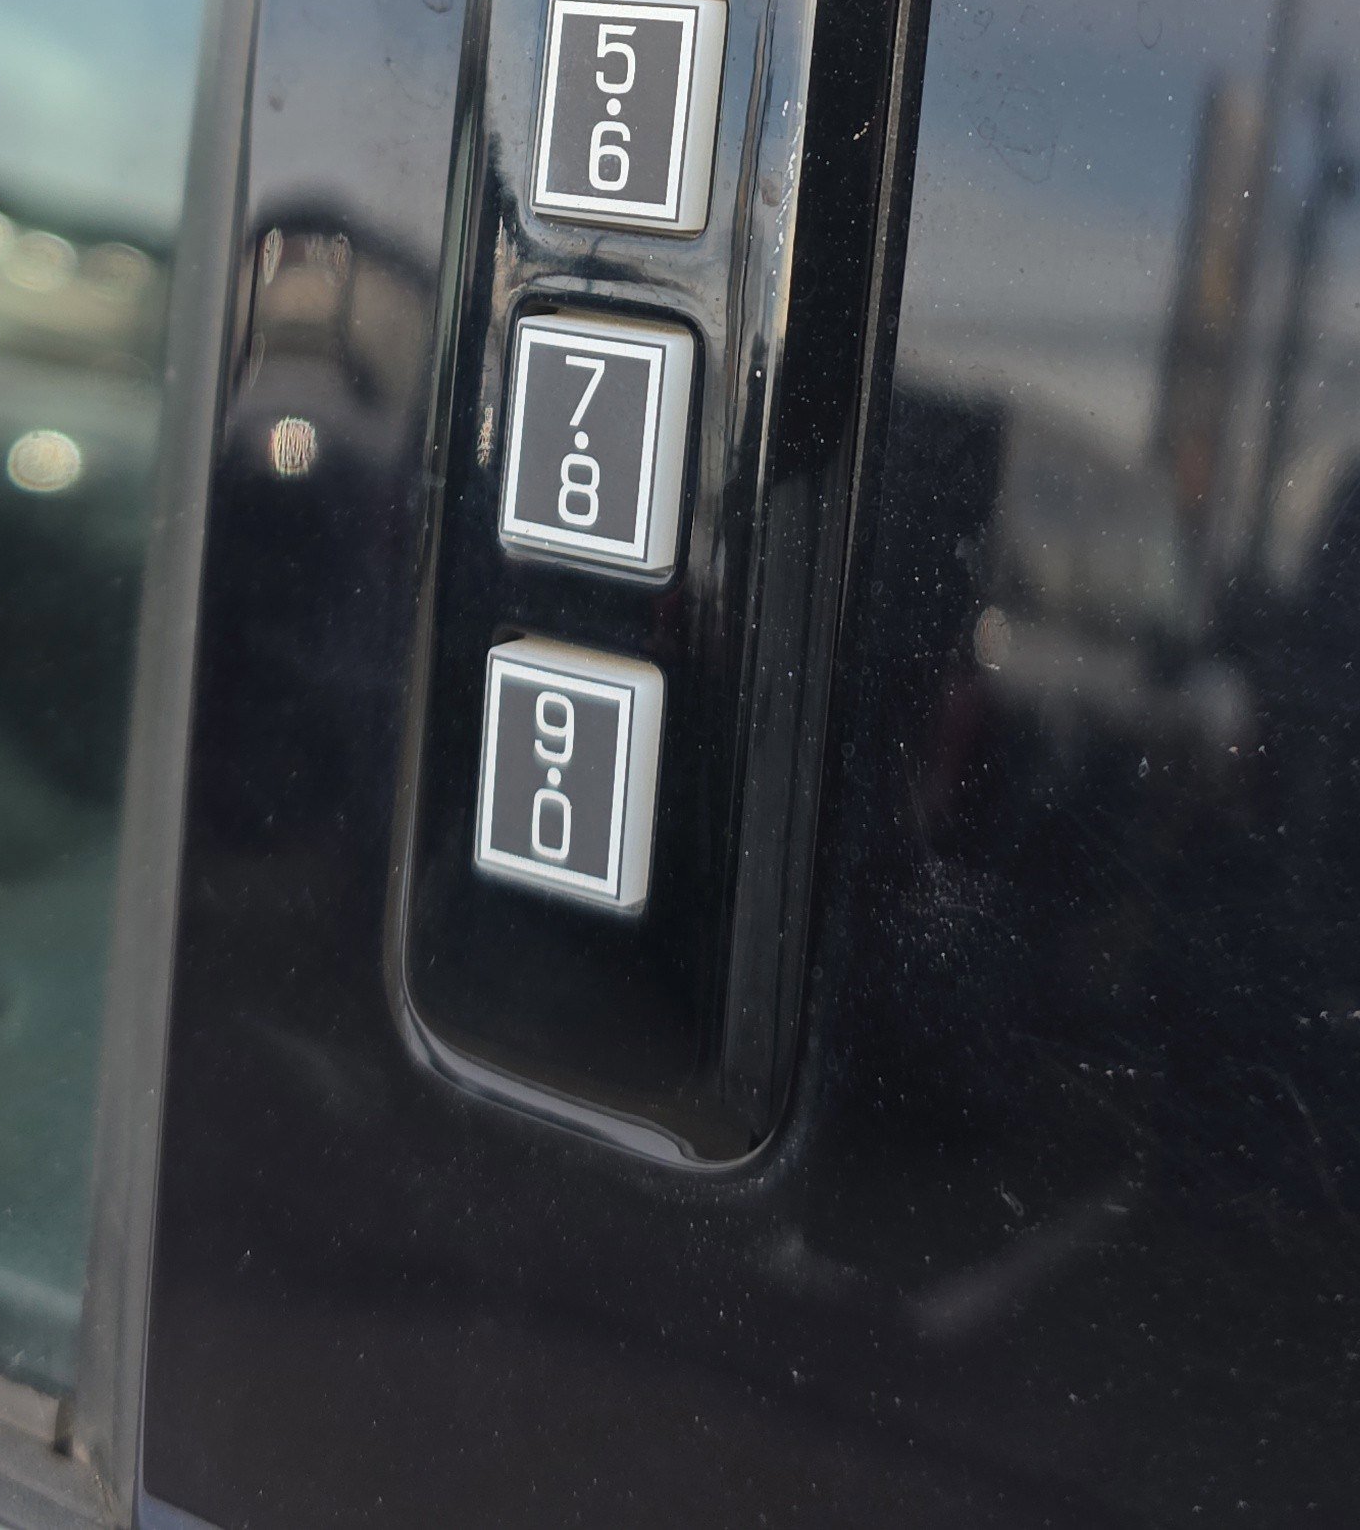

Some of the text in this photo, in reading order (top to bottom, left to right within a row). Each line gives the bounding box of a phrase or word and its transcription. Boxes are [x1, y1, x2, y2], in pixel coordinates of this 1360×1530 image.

[595, 23, 637, 95] 5
[588, 120, 631, 192] 6
[565, 354, 606, 427] 7
[557, 453, 600, 527] 8
[534, 691, 575, 765] 9
